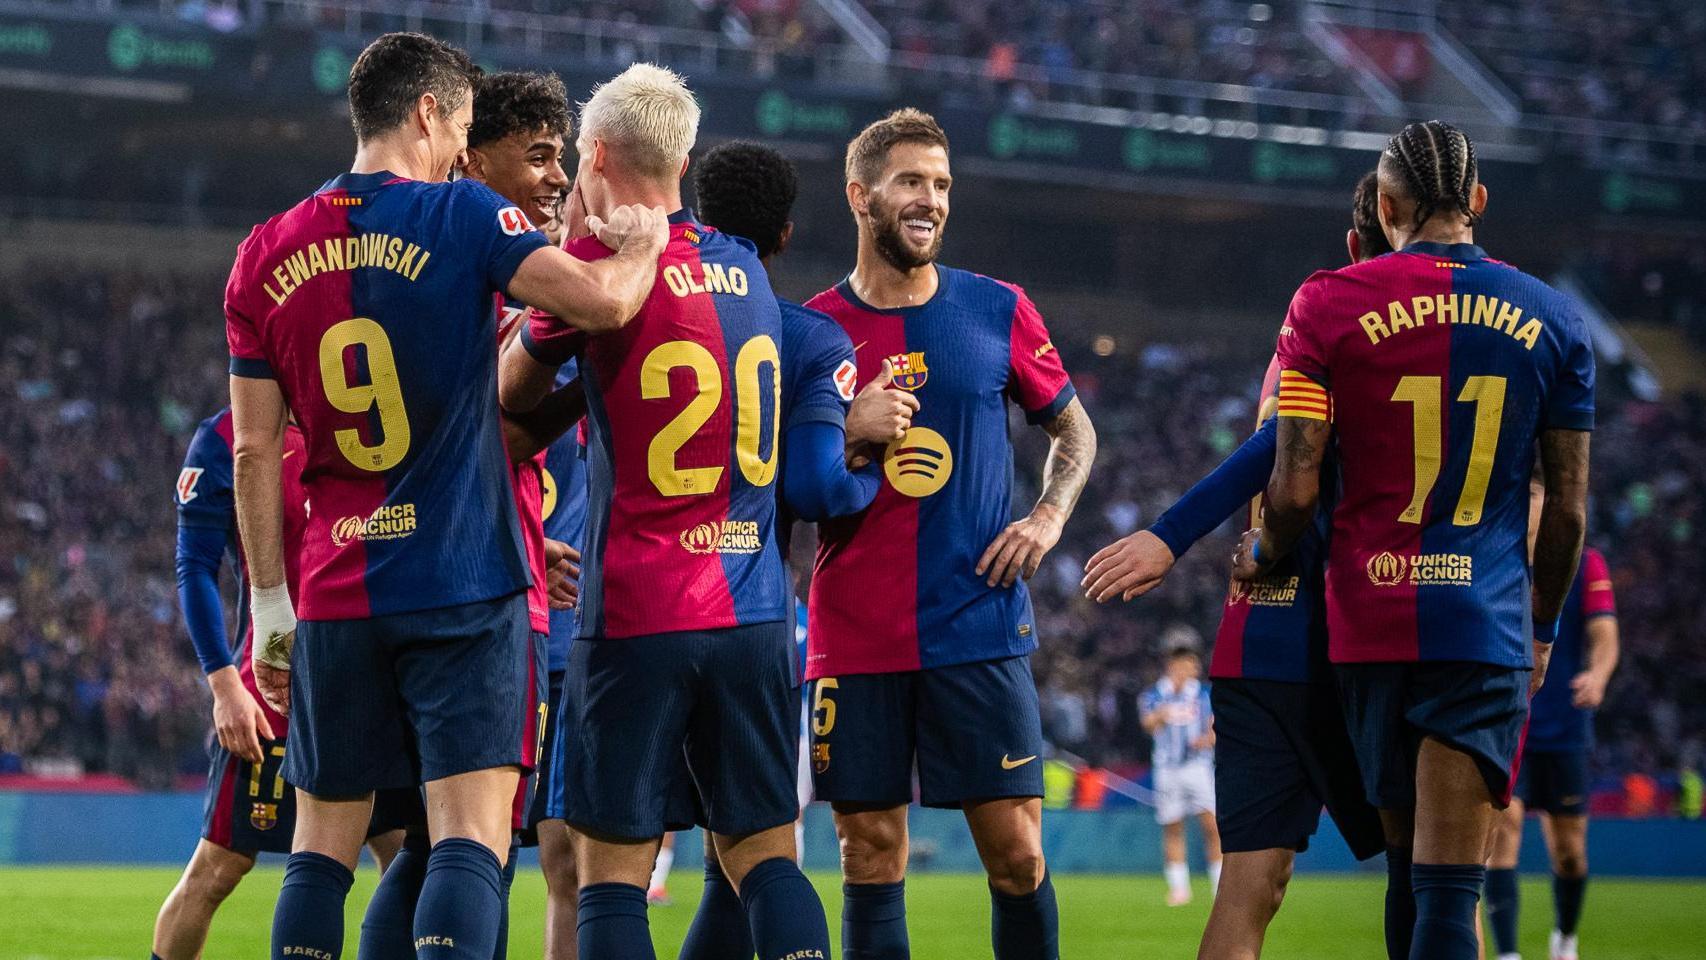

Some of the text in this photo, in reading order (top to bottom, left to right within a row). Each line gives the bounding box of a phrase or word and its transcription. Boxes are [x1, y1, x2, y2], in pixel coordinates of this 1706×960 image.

[262, 233, 431, 307] LEWANDOWSKI
[663, 262, 749, 298] OLMO
[1359, 294, 1544, 351] RAPHINHA
[319, 318, 411, 471] 9
[640, 335, 782, 497] 20
[1390, 375, 1508, 527] 11
[1409, 566, 1472, 581] ACNUR
[1410, 553, 1472, 569] UNHCR
